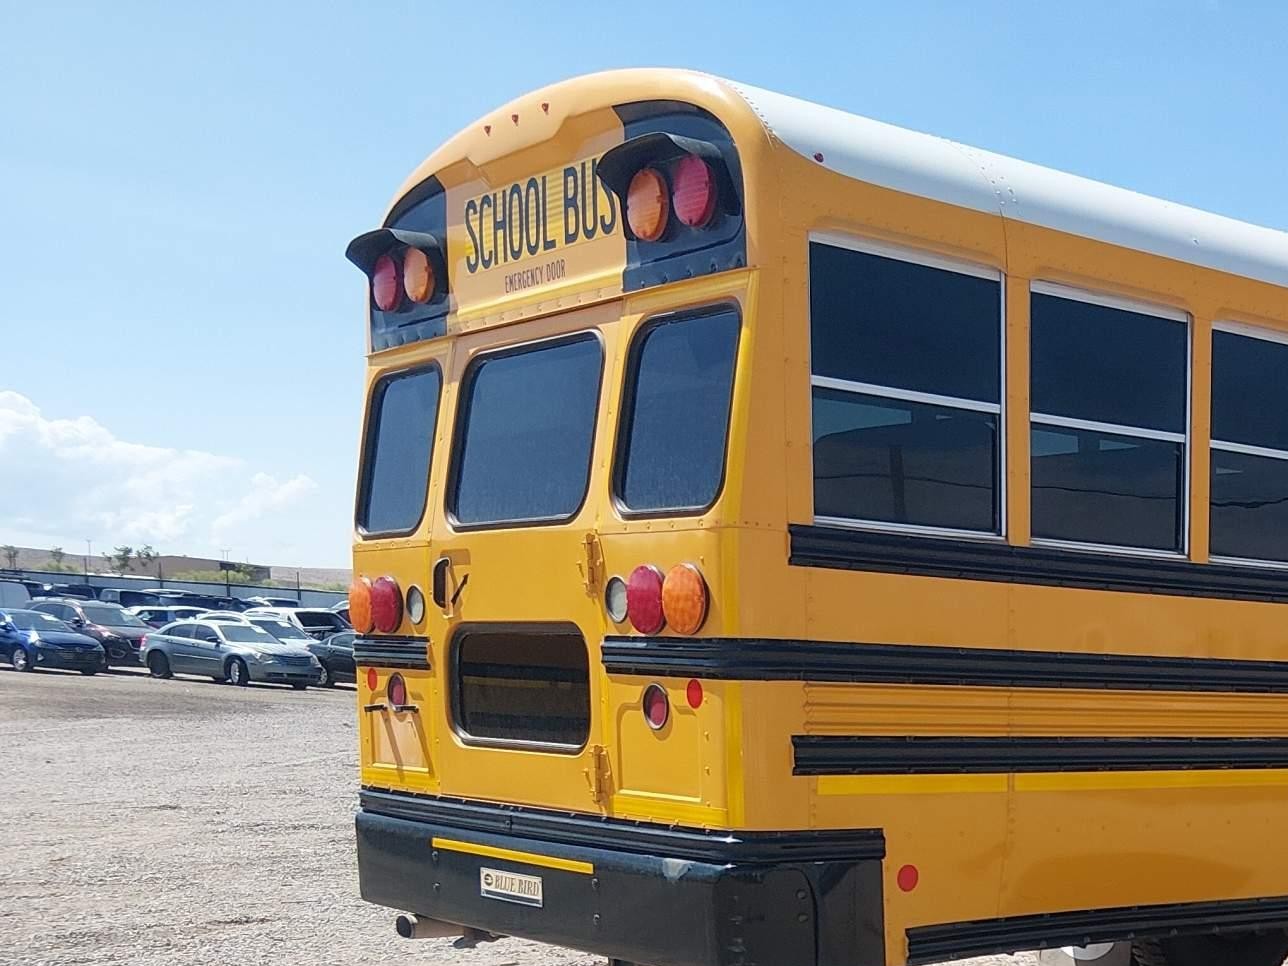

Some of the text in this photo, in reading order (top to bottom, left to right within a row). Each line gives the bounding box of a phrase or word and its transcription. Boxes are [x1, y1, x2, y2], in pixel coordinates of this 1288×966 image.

[465, 158, 617, 274] SCHOOL BUS
[505, 258, 566, 293] EMERGENCY DOOR
[494, 874, 540, 896] BLUE BIRD
